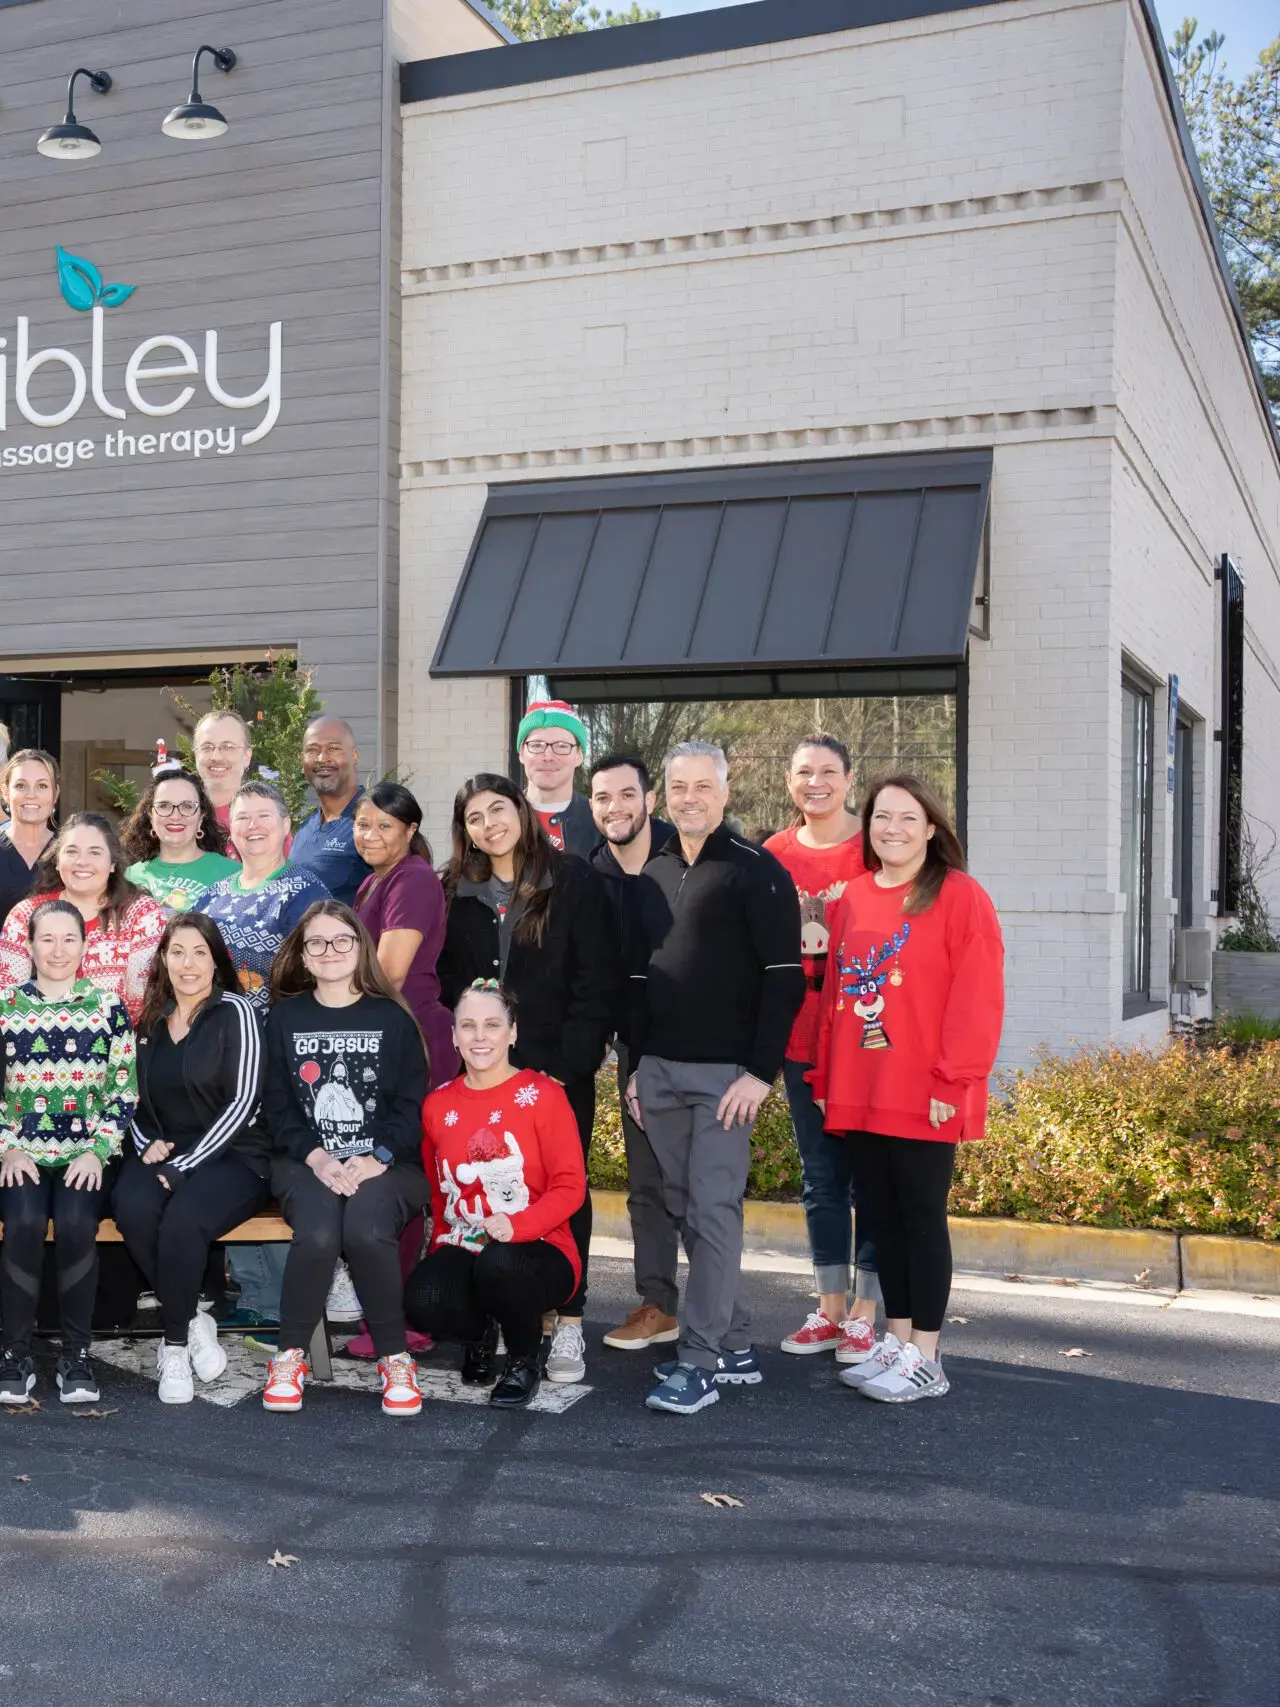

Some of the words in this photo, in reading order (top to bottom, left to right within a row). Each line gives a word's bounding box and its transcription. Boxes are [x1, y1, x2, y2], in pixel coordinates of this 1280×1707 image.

[105, 425, 236, 459] therapy
[295, 1038, 319, 1055] GO
[337, 1122, 361, 1133] your
